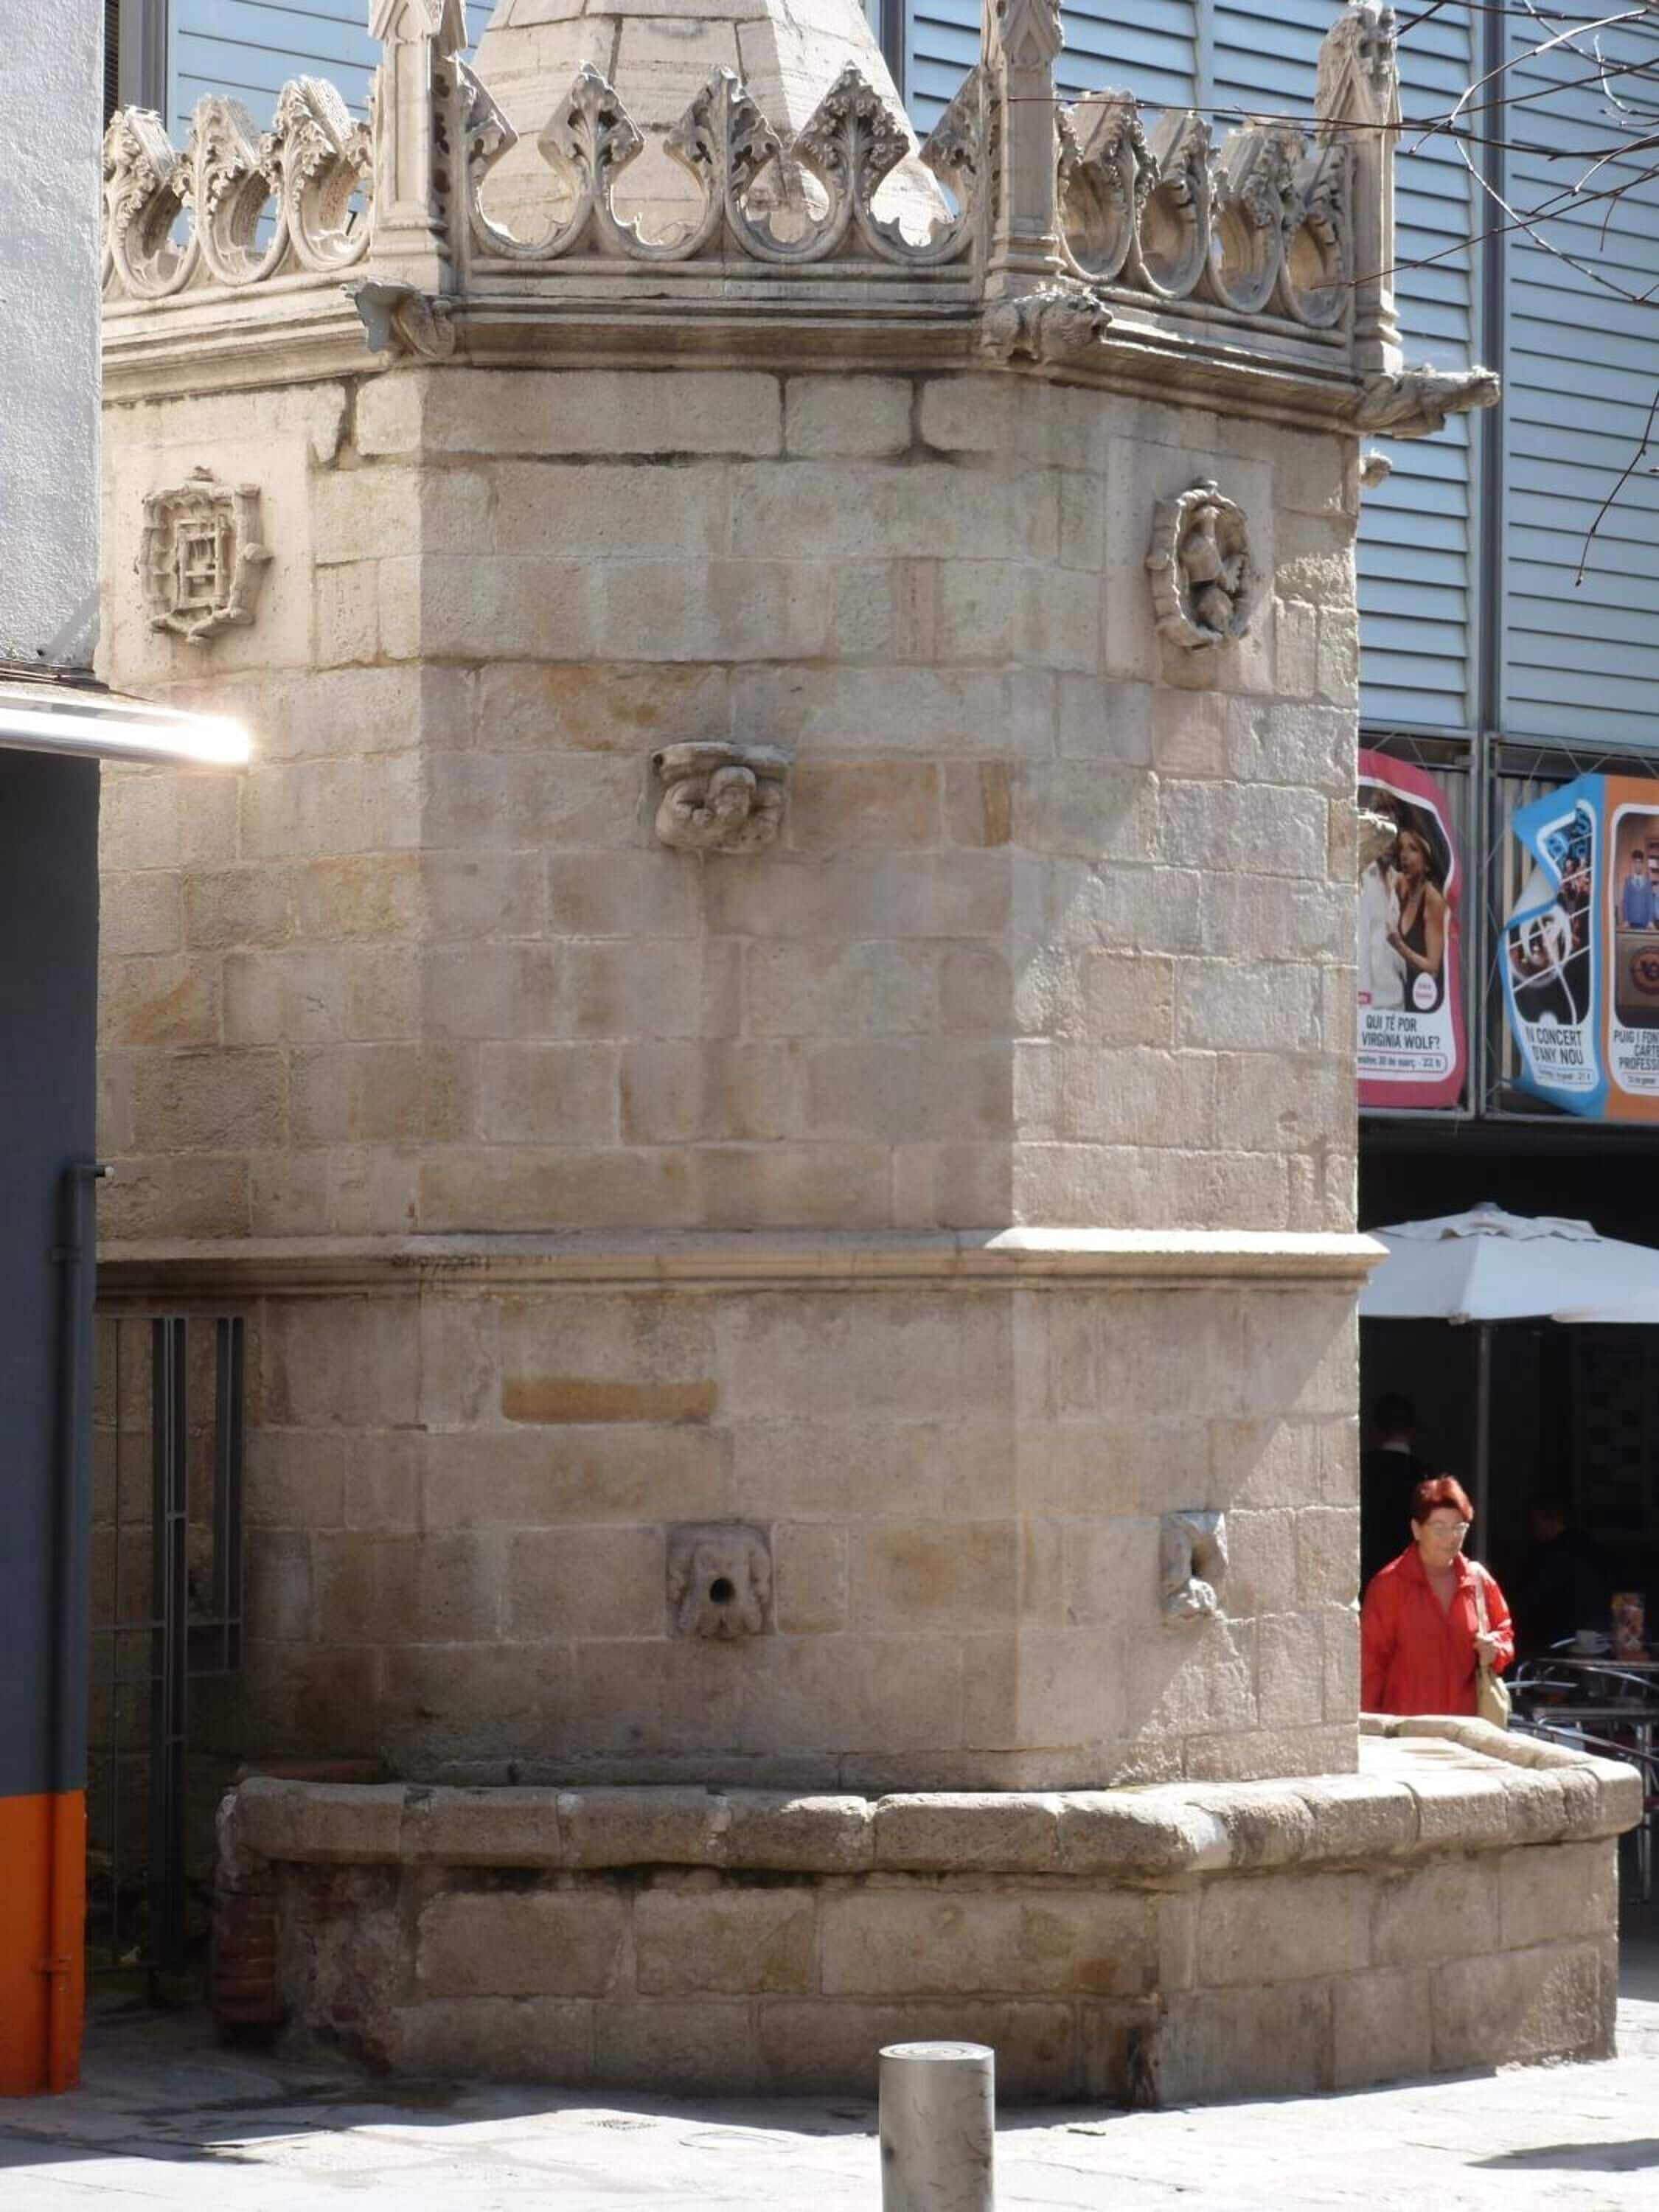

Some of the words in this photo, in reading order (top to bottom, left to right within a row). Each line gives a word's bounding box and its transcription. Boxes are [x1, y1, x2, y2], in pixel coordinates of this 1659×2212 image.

[1366, 1015, 1382, 1029] QUI
[1398, 1018, 1416, 1032] POR
[1404, 1035, 1440, 1049] WOLF?
[1537, 1028, 1582, 1046] CONCERT
[1559, 1048, 1584, 1065] NOU
